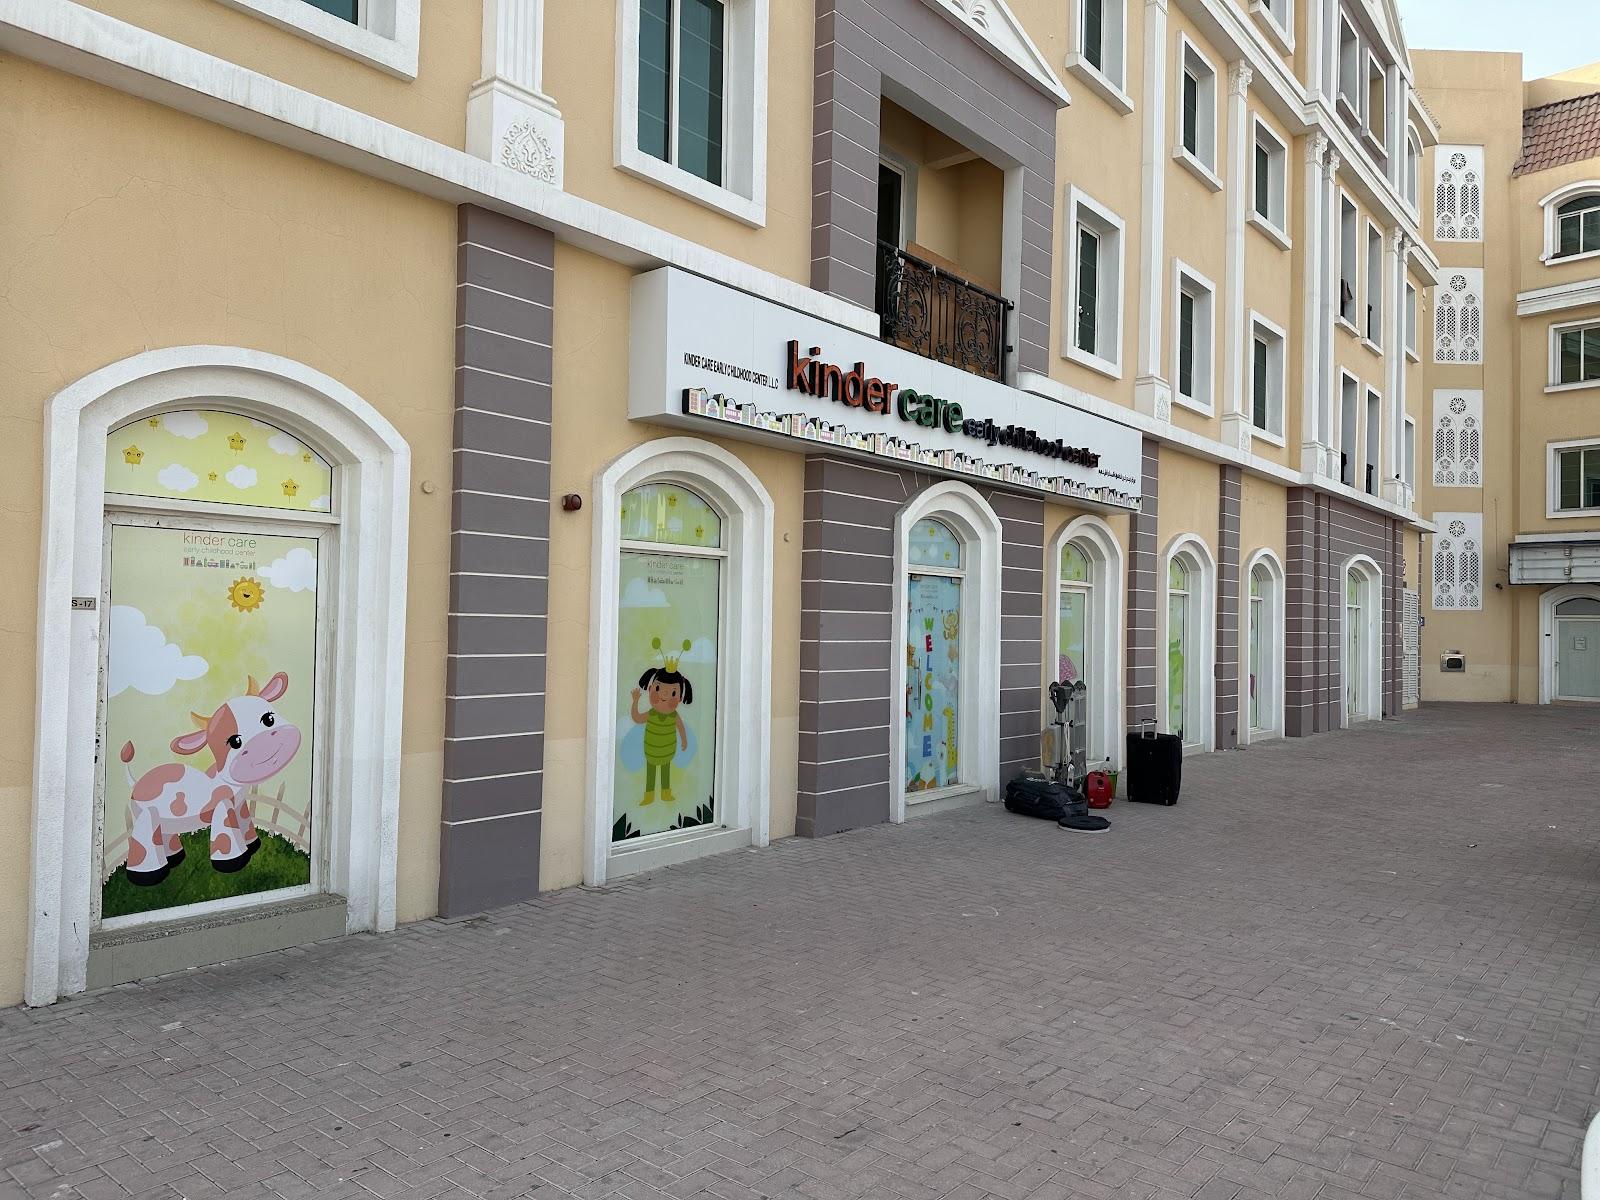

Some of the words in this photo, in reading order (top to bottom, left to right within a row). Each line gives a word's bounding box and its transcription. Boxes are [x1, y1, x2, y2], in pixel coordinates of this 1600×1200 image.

[684, 352, 701, 367] KINDER
[701, 357, 714, 371] CARE
[714, 360, 728, 375] EARLY
[752, 371, 769, 388] CENTER
[787, 340, 898, 415] kinder
[897, 388, 964, 433] care
[963, 418, 1001, 446] early
[183, 532, 225, 546] kinder
[227, 537, 257, 549] care
[183, 546, 200, 554] early
[201, 547, 234, 555] childhood
[922, 617, 935, 758] WELCOME
